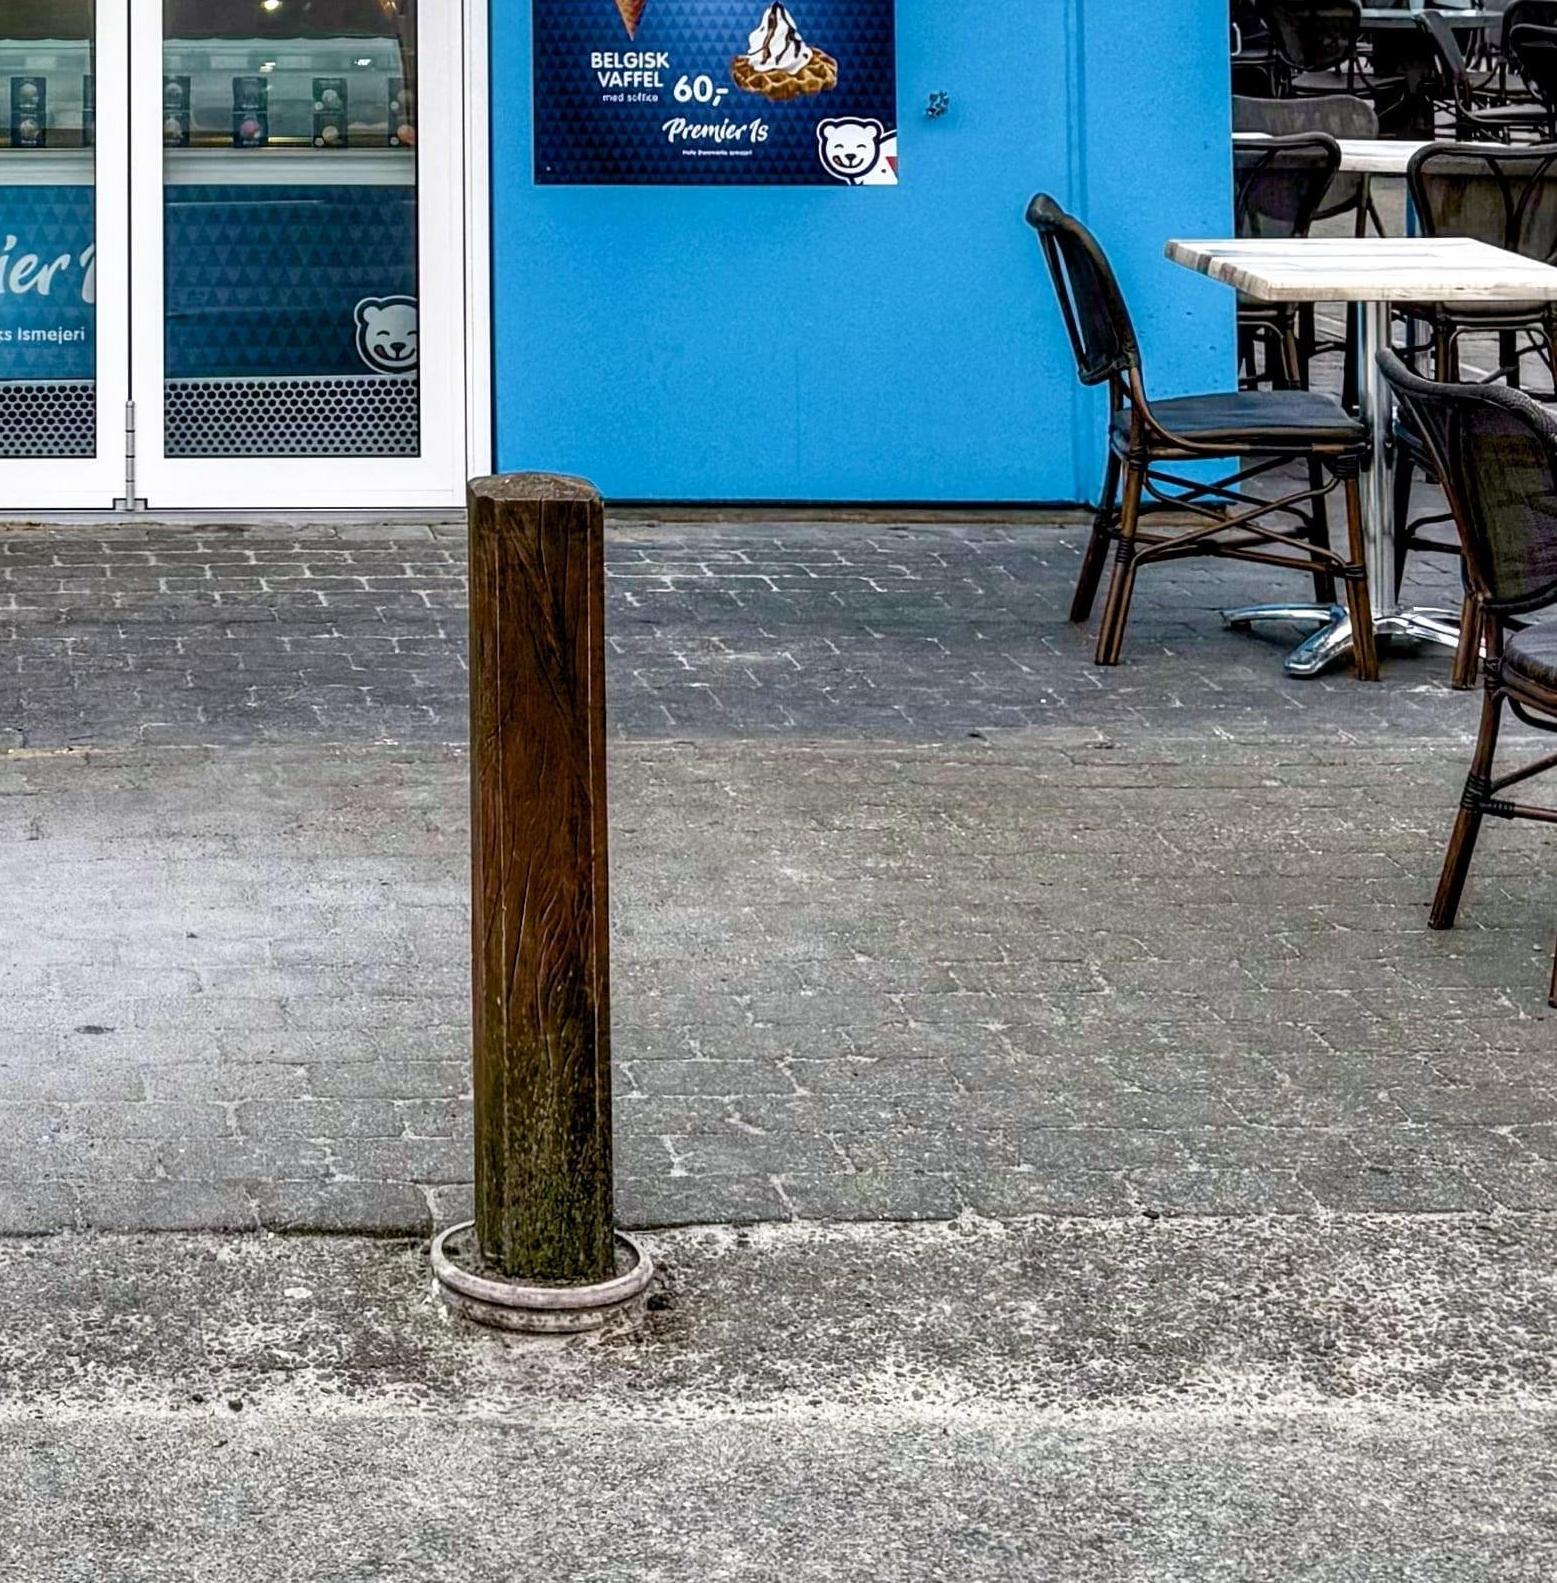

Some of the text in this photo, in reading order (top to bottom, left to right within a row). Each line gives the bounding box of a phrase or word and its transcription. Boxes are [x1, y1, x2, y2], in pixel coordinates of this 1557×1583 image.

[591, 52, 670, 69] BELGISK
[597, 71, 664, 87] VAFFEL
[673, 74, 729, 107] 60,-
[662, 117, 748, 143] Premier
[18, 326, 85, 344] Ismejeri
